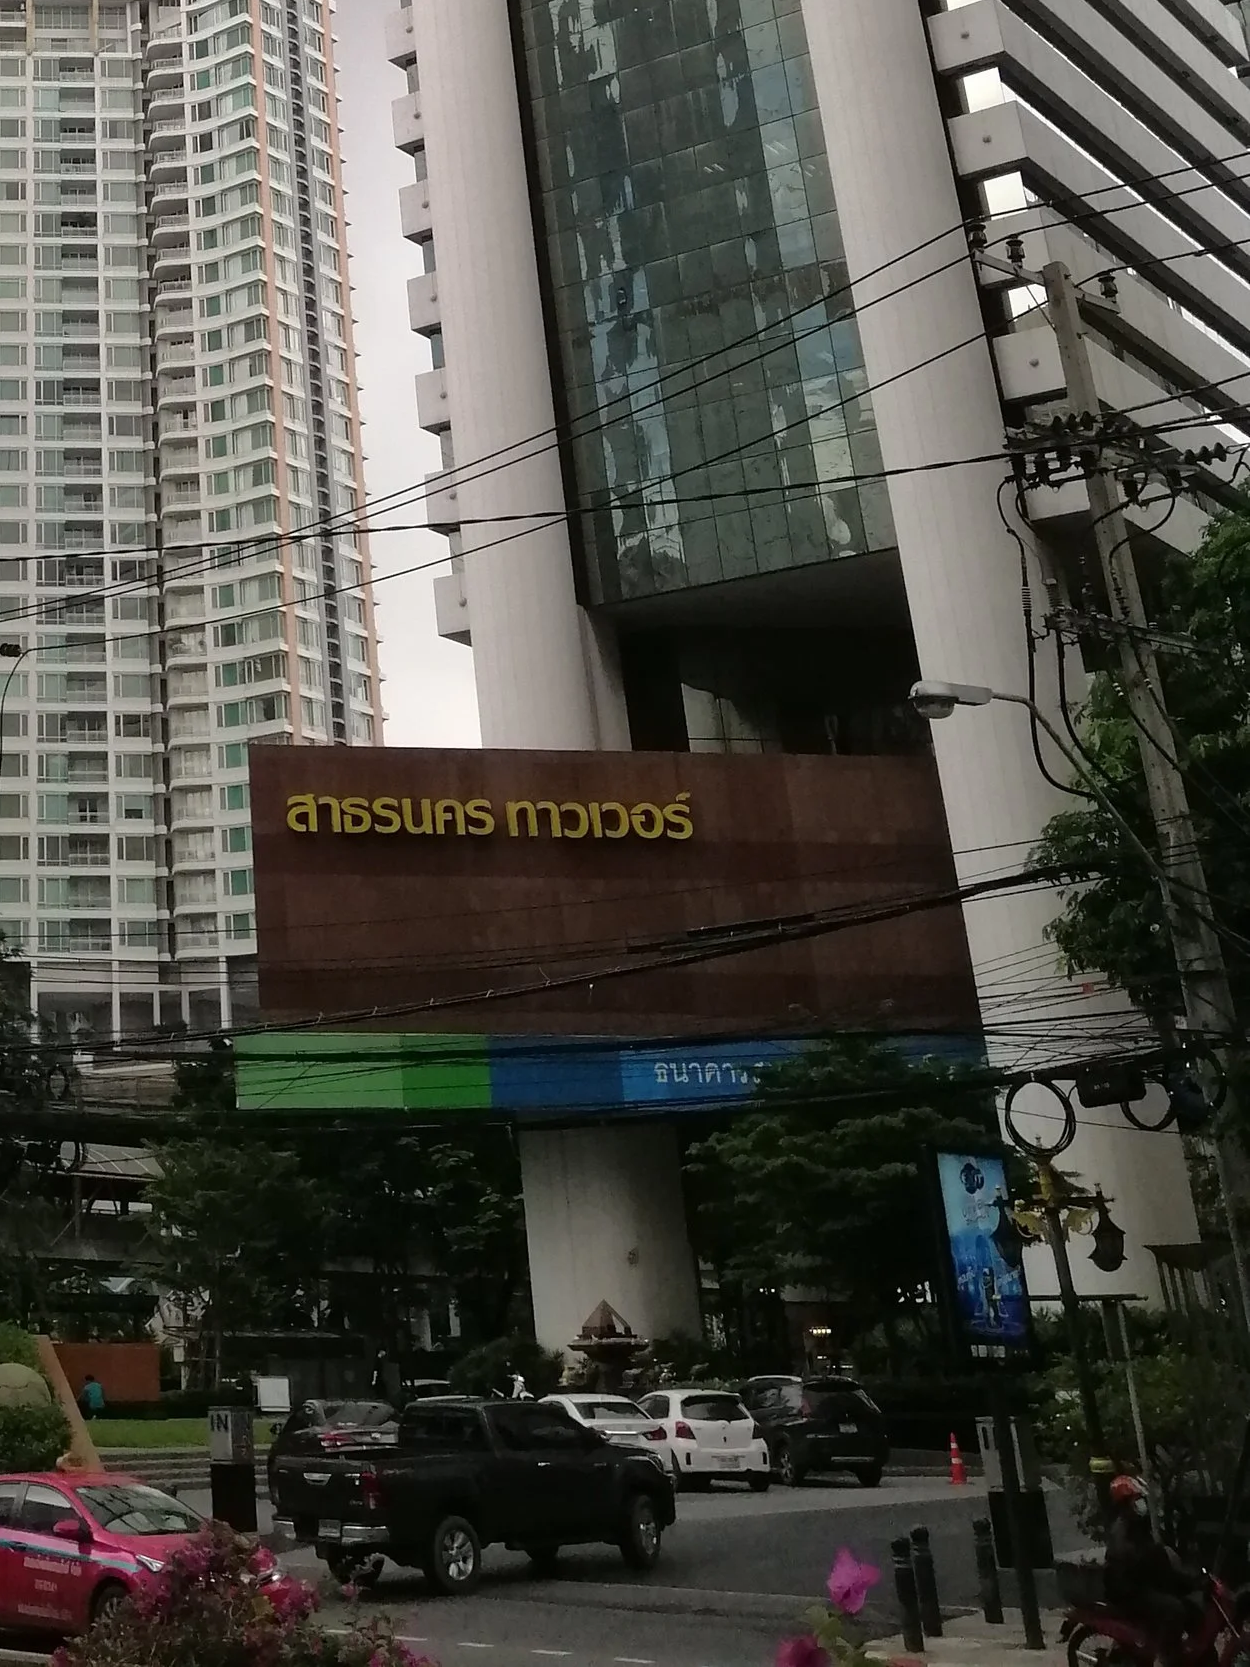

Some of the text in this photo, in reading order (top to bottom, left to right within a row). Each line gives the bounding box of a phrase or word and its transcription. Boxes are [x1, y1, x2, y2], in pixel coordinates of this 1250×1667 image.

[285, 791, 694, 840] สาธรนคร ทาวเวอร์
[210, 1413, 228, 1432] IN
